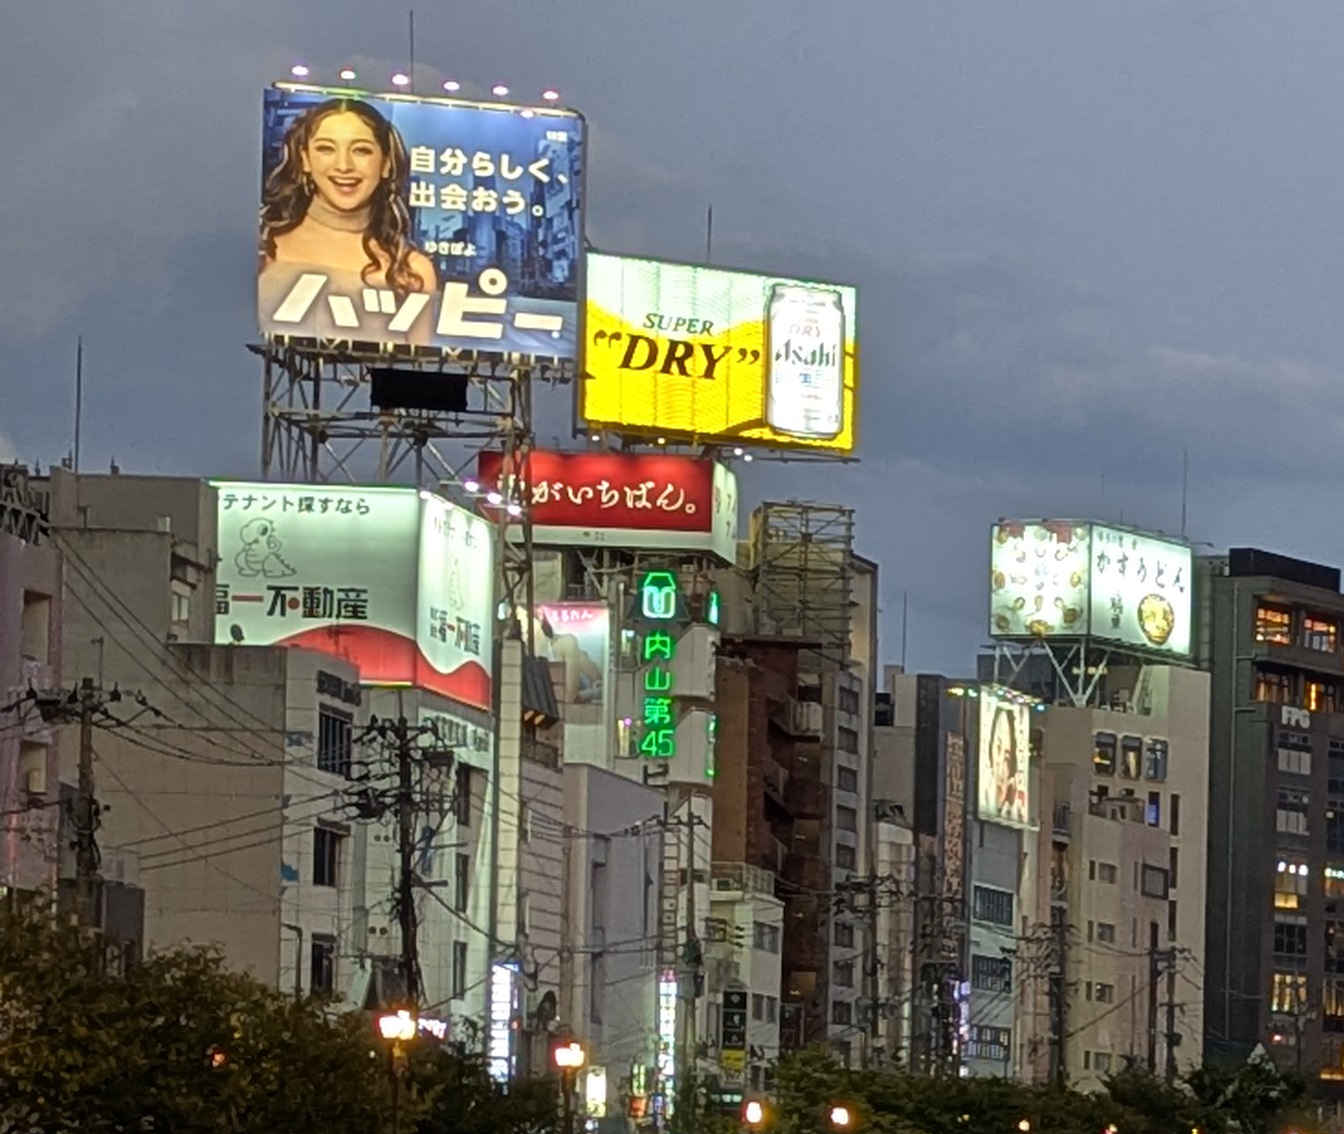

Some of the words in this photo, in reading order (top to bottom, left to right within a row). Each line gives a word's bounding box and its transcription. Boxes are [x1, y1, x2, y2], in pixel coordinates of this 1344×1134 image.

[411, 146, 568, 183] 自分らしく、
[409, 180, 544, 217] 出会おう。
[273, 267, 563, 339] ハッピー
[643, 312, 714, 336] SUPER
[774, 339, 837, 367] Asahi
[223, 494, 371, 516] テナント探すなら
[1281, 705, 1311, 729] FPG
